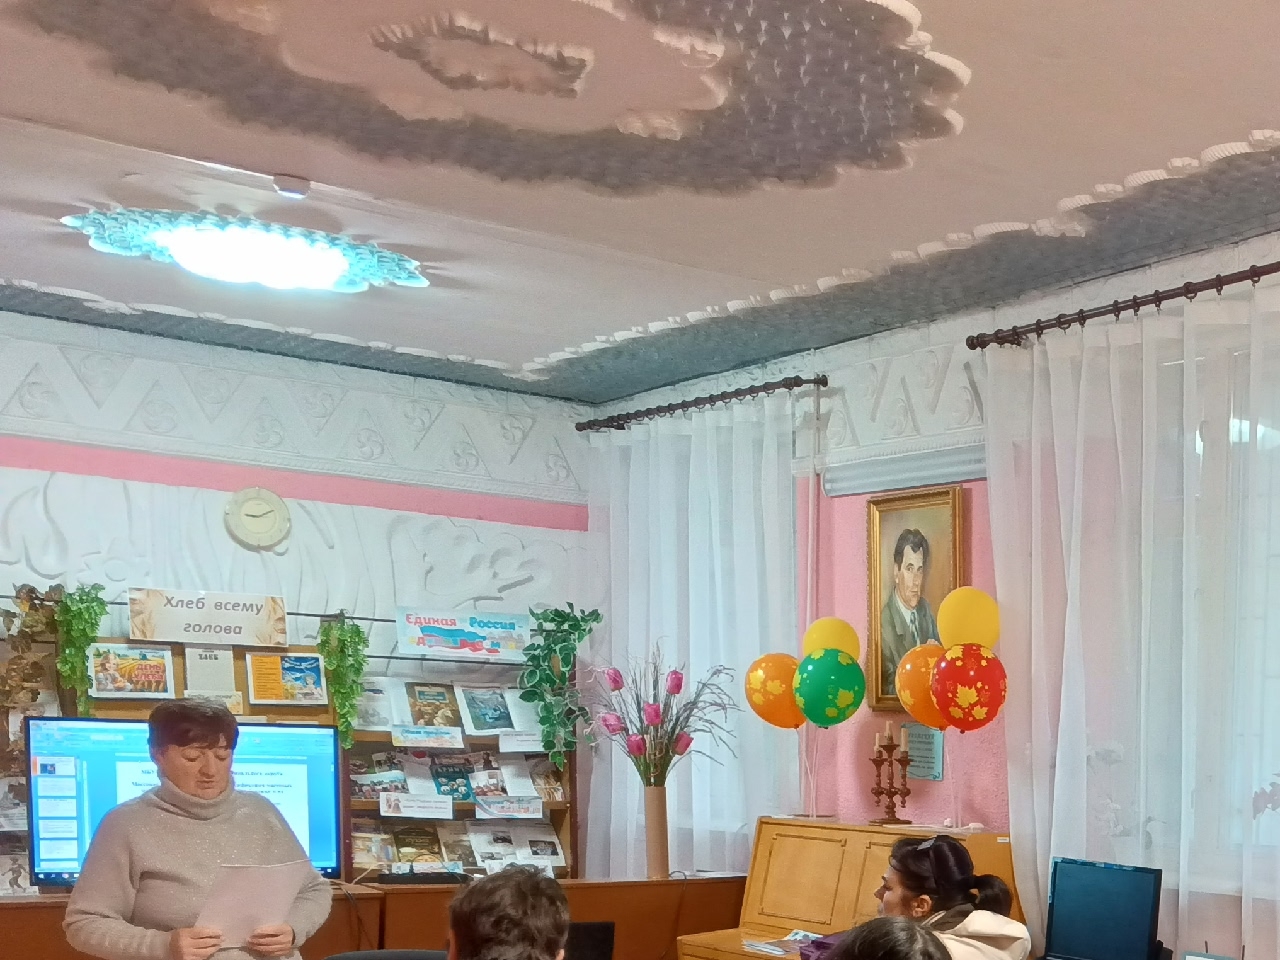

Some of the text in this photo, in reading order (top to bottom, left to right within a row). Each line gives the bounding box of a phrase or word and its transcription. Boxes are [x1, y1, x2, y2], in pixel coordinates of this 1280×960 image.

[163, 595, 264, 616] Хлеб всему
[183, 622, 243, 636] голова
[405, 613, 457, 628] Единая
[469, 616, 516, 632] Россия
[135, 663, 163, 672] ДЕНЬ
